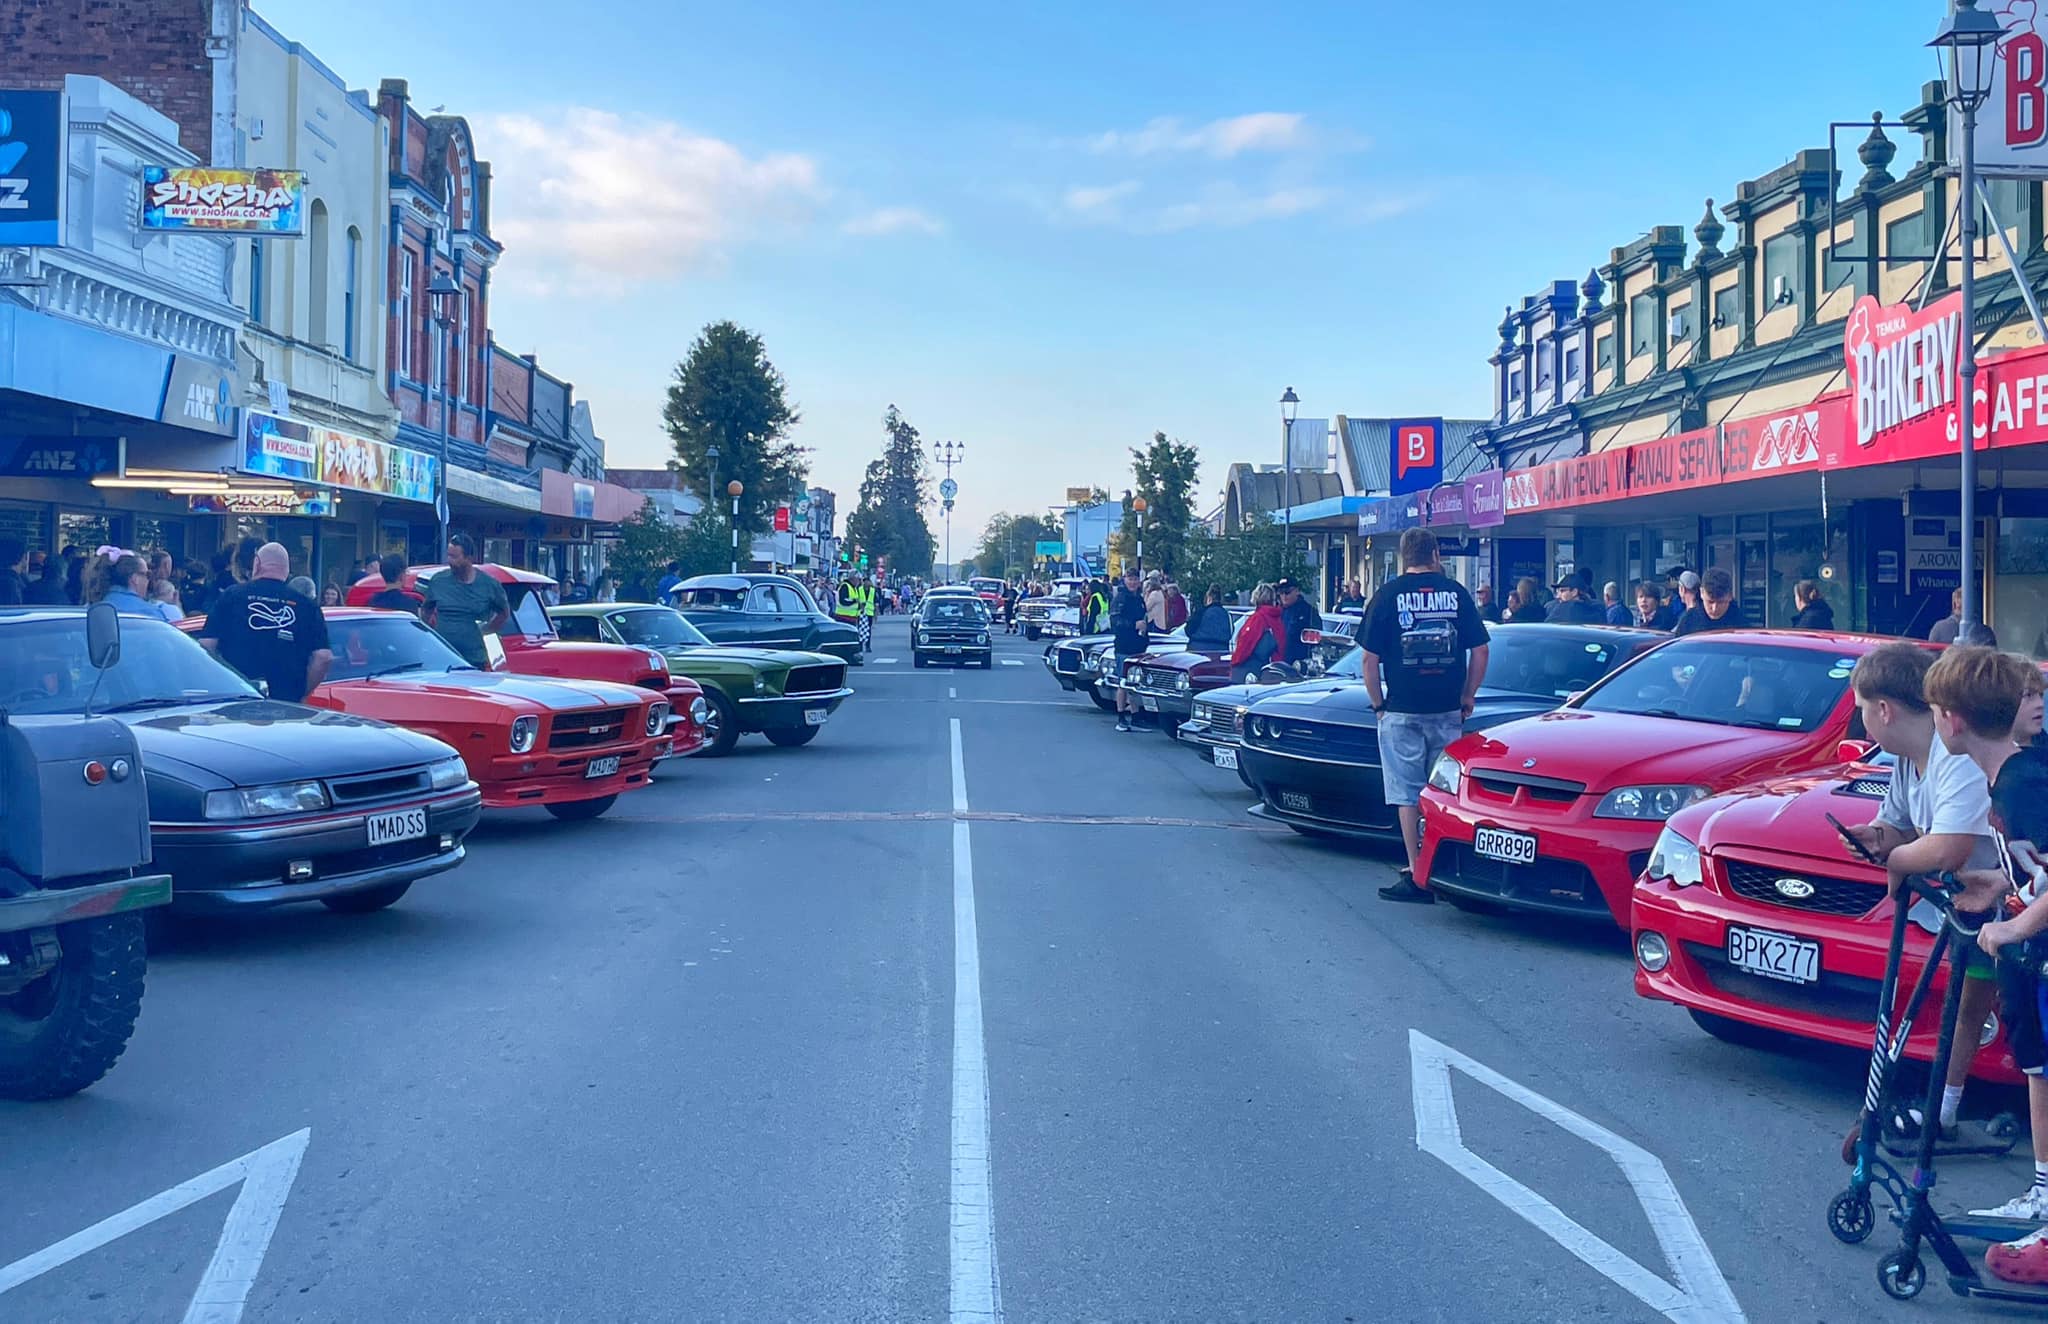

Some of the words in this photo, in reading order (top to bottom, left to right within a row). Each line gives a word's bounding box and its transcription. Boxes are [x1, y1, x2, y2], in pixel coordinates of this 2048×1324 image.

[172, 206, 271, 218] WWW.SHOSHA.CO.NZ
[1876, 316, 1907, 338] TEMUKA
[1857, 311, 1960, 447] BAKERY
[184, 383, 215, 422] ANZ
[23, 450, 76, 471] ANZ
[1408, 432, 1426, 461] B
[1397, 591, 1459, 612] BADLANDS
[1477, 831, 1534, 860] GRR890
[1730, 931, 1817, 977] BPK277
